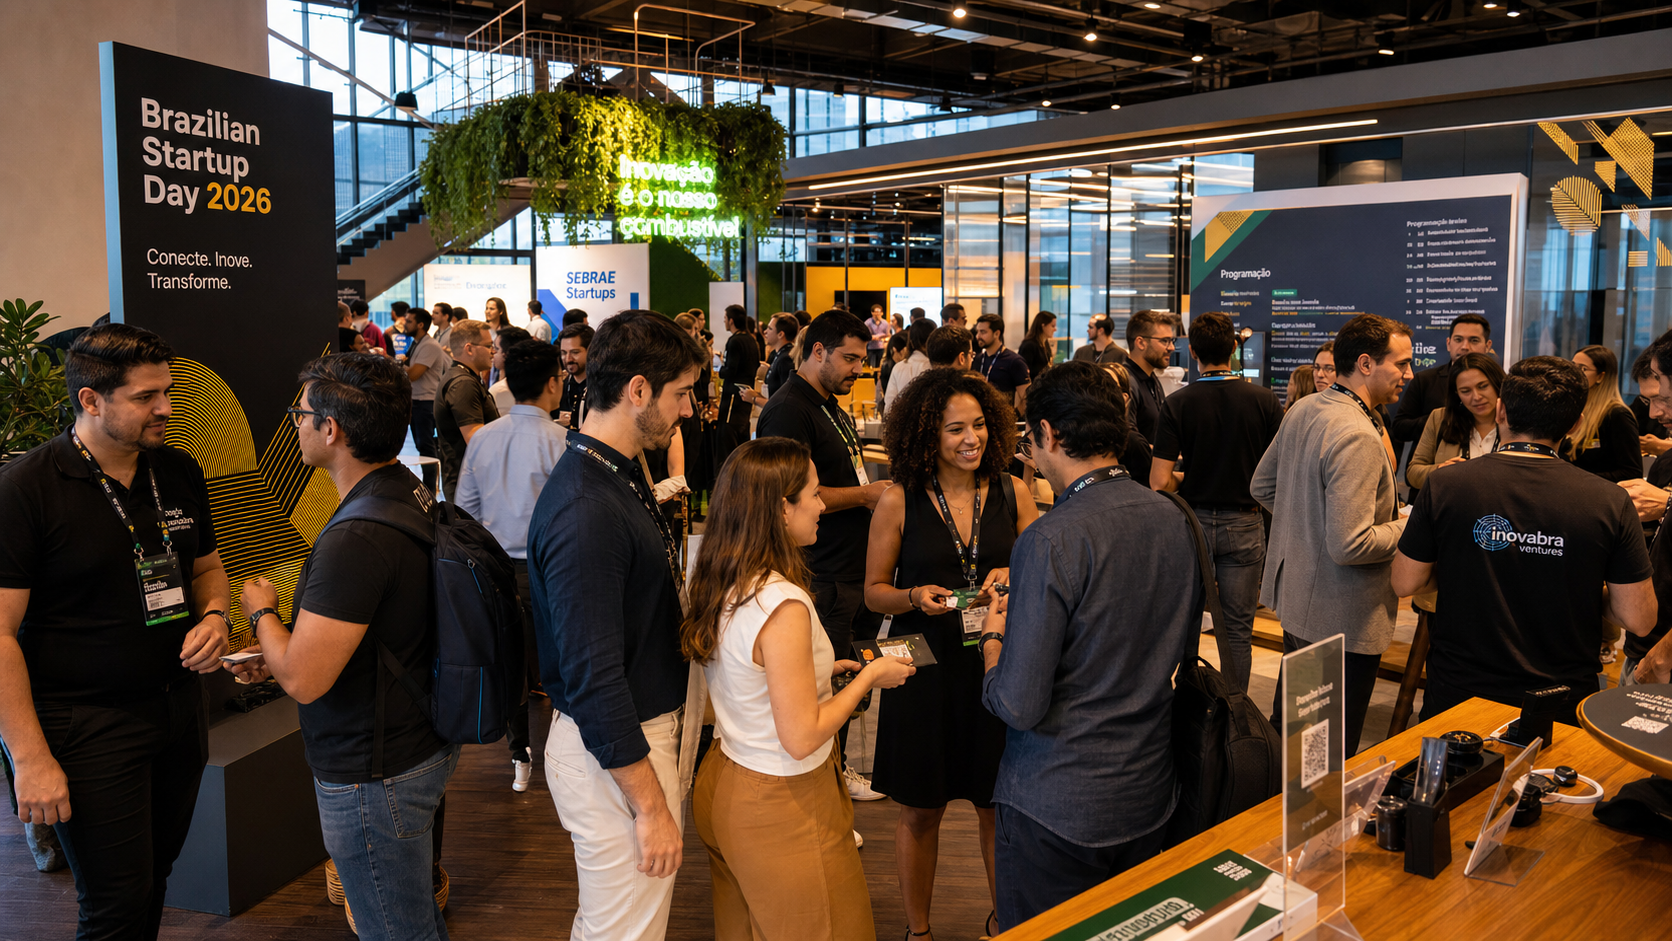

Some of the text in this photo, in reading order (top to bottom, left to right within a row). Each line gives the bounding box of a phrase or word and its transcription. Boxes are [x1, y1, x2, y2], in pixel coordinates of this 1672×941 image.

[141, 97, 260, 146] Brazilian
[142, 136, 250, 183] Startup
[619, 154, 714, 187] Inovação
[143, 174, 272, 214] Day 2026
[620, 183, 718, 209] é o nosso
[146, 248, 253, 268] Conecte. Inove.
[147, 272, 232, 290] Transforme.
[566, 271, 616, 284] SEBRAE
[1220, 268, 1271, 280] Programação
[566, 287, 616, 301] Startups
[1491, 526, 1564, 547] inovabra
[1519, 545, 1564, 556] ventures
